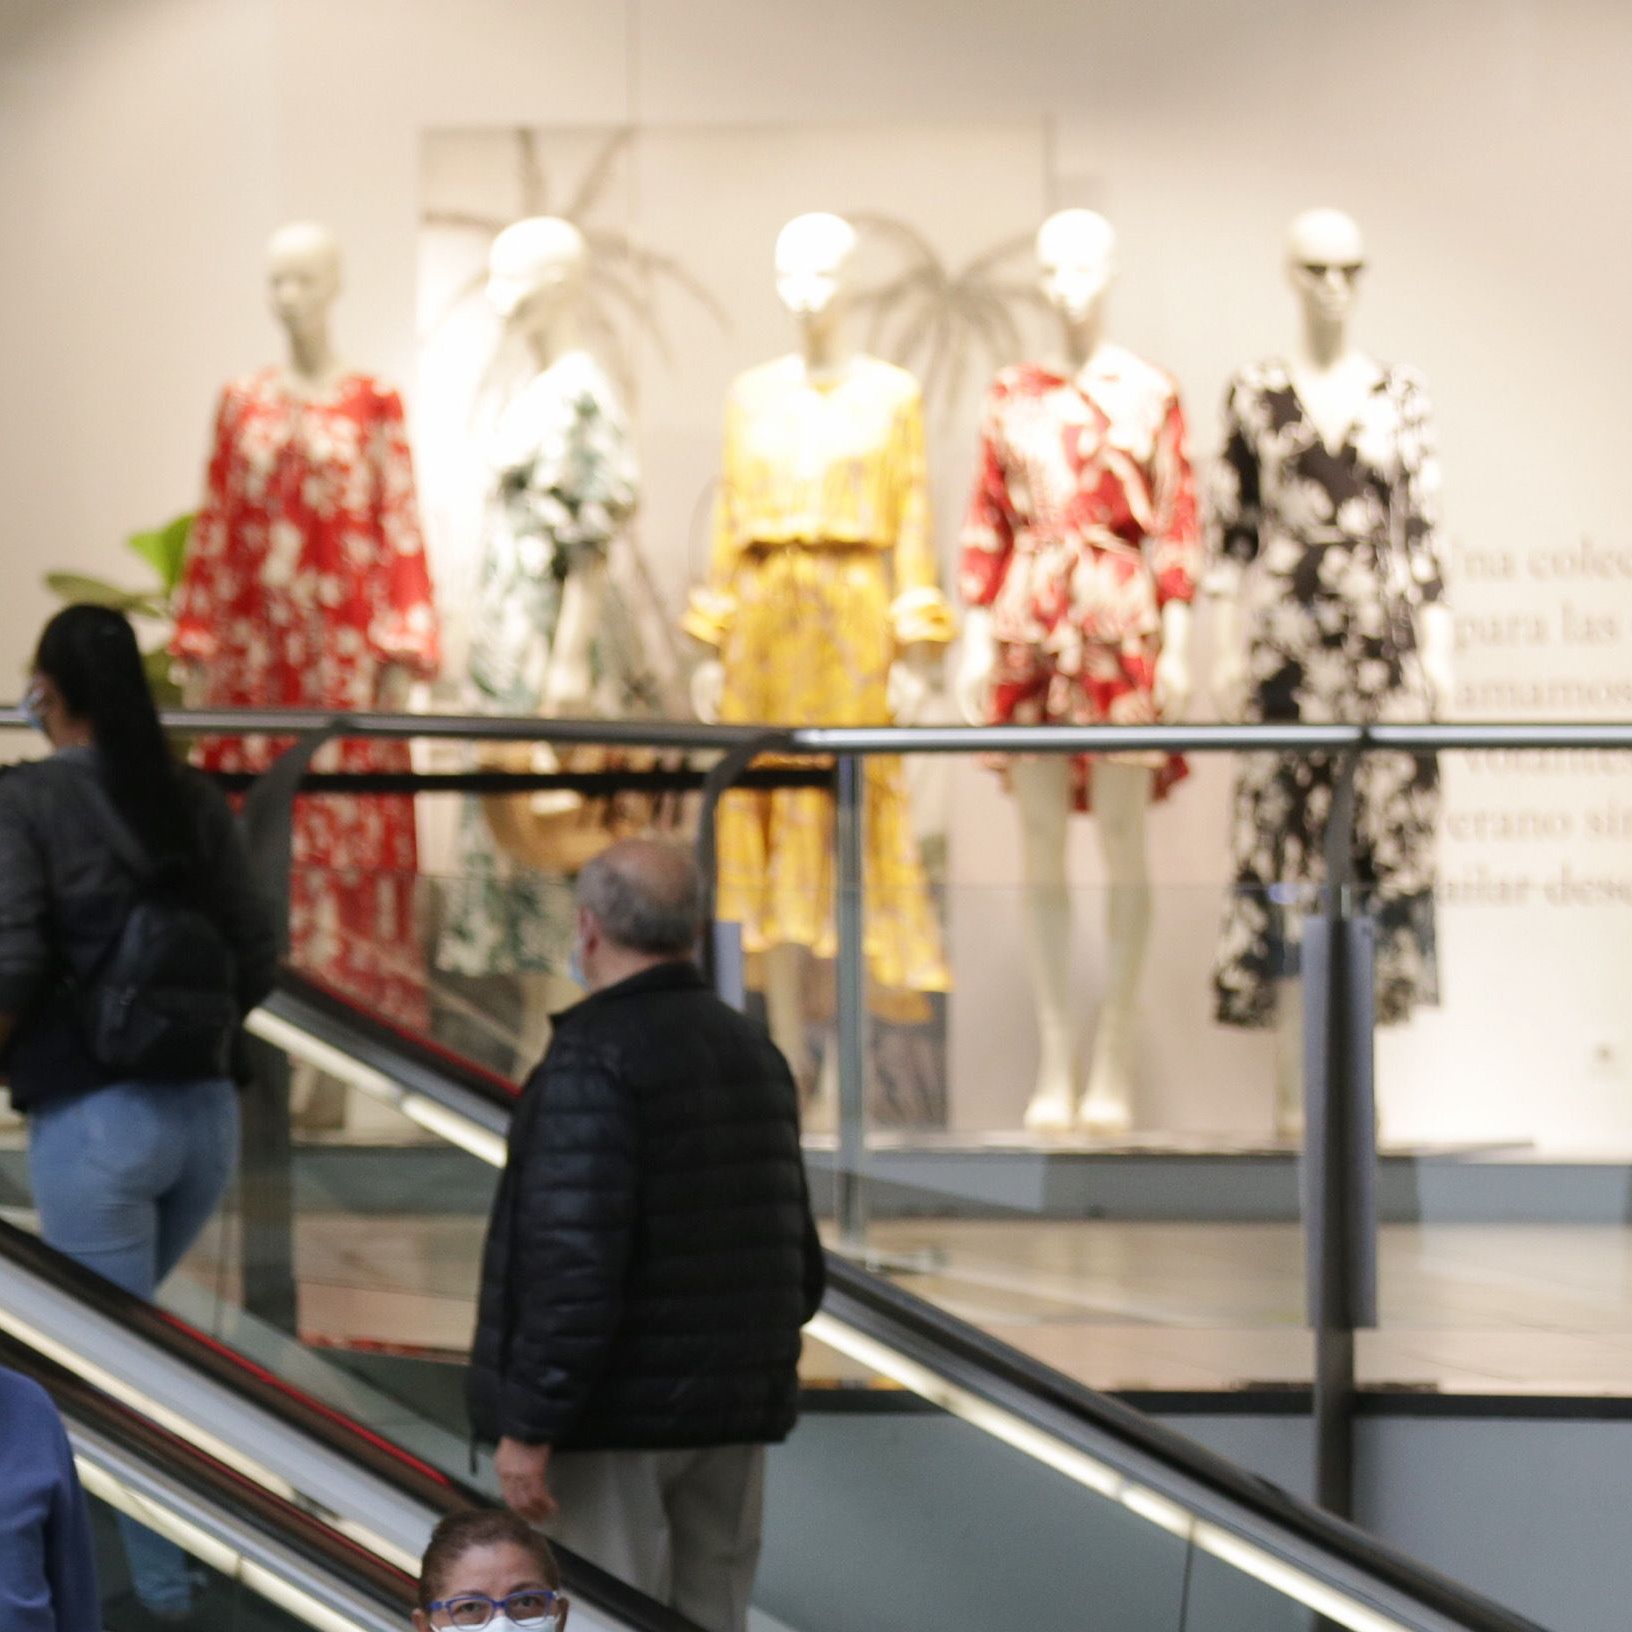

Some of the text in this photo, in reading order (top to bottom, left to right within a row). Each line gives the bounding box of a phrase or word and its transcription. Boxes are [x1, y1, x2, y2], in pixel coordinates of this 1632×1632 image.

[1454, 611, 1549, 656] para
[1562, 599, 1620, 645] las
[1447, 807, 1573, 842] erano
